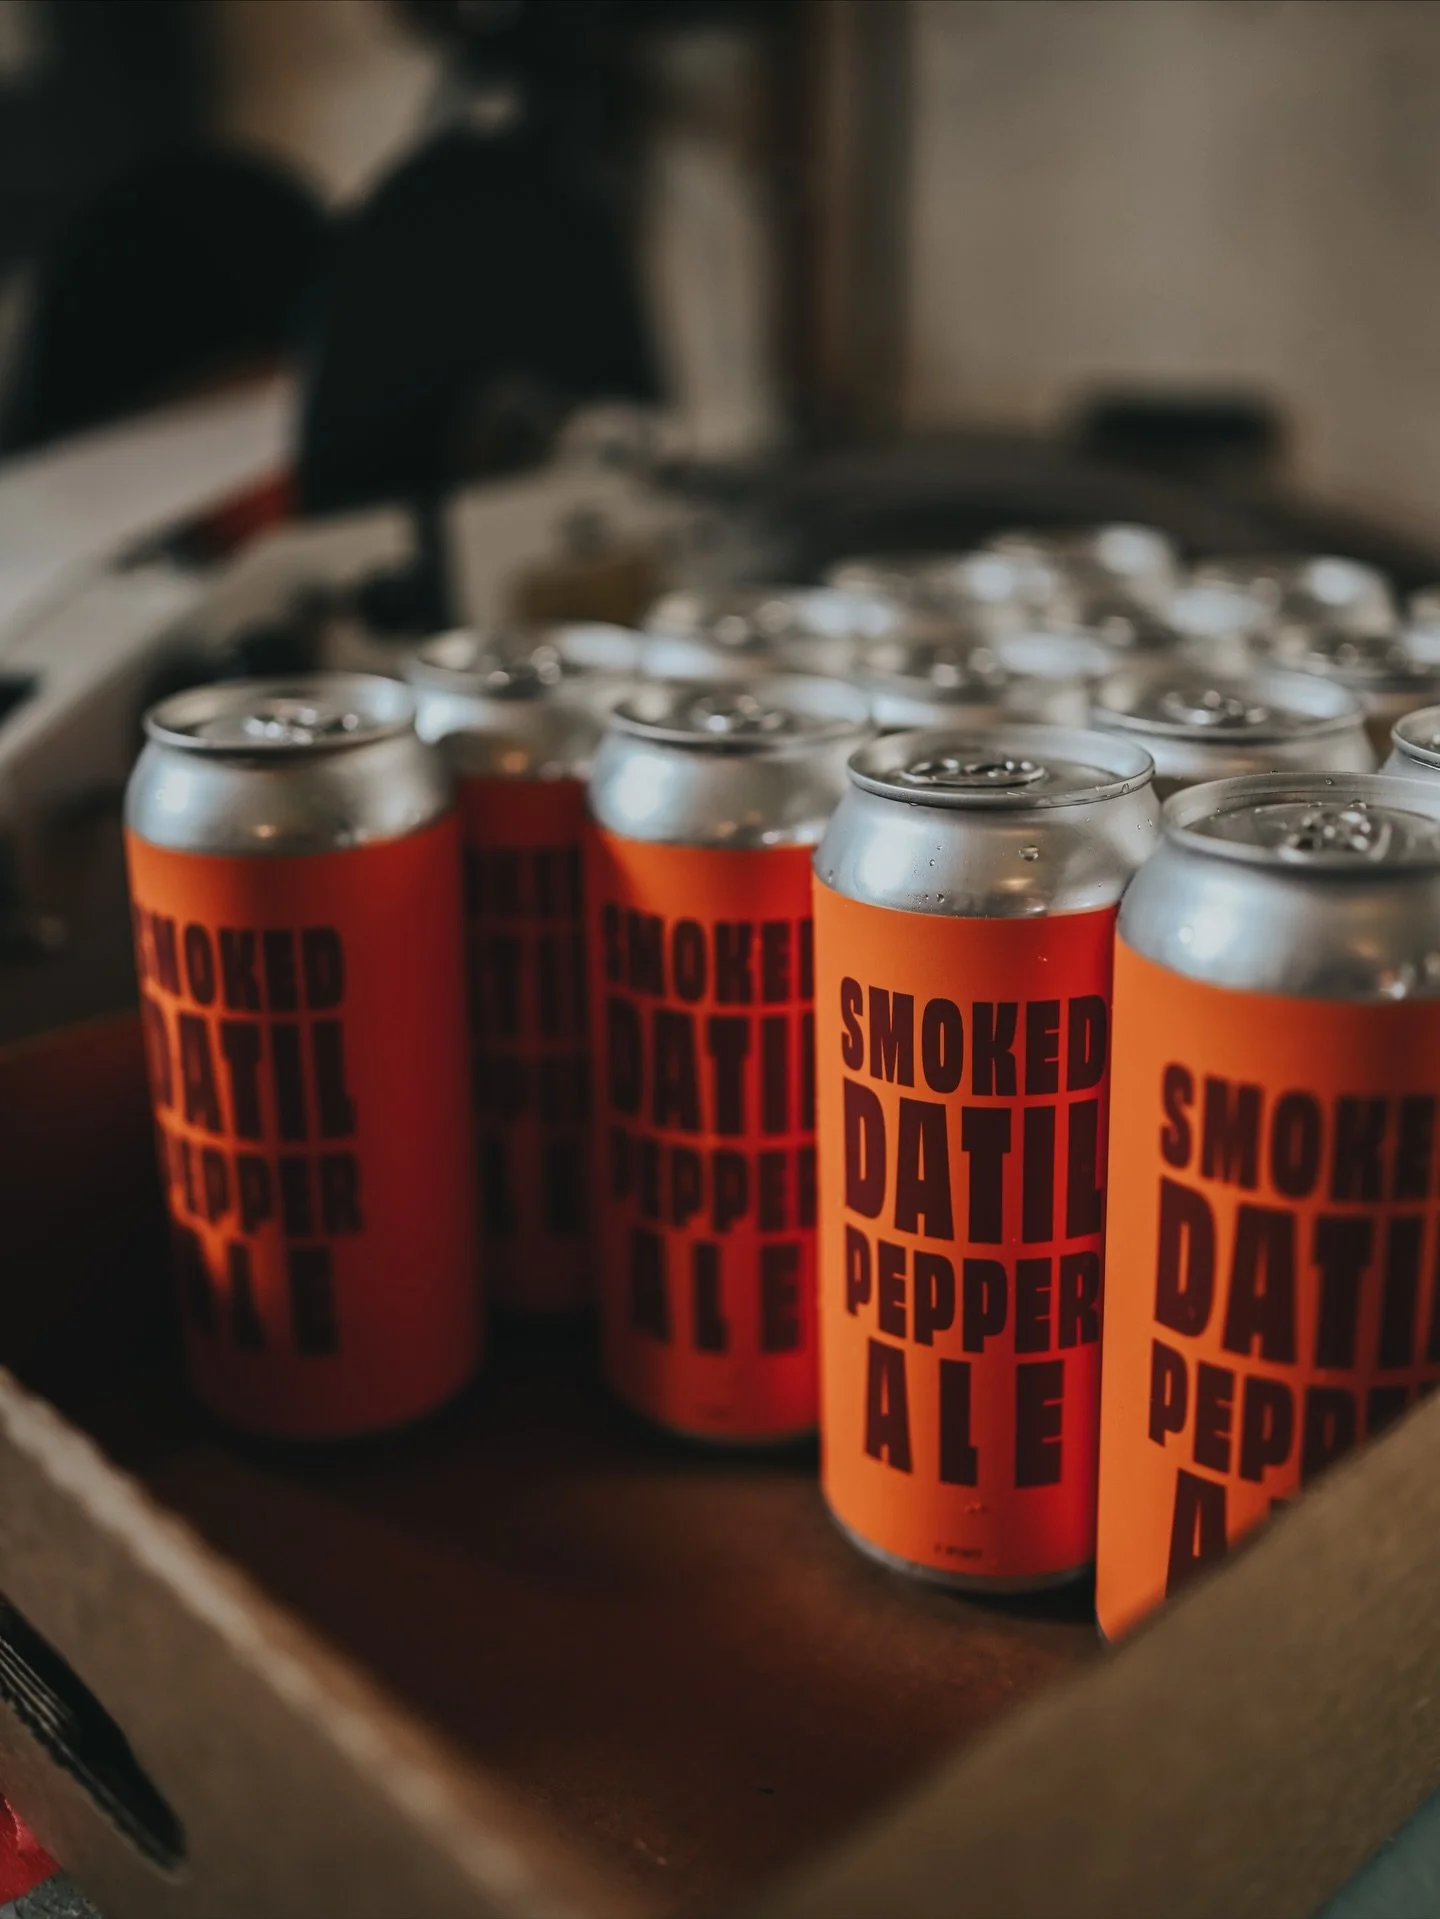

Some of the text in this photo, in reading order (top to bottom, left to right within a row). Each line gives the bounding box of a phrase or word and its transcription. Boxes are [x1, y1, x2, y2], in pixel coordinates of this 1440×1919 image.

[135, 902, 346, 1011] MOKED
[840, 976, 1107, 1096] SMOKED
[843, 1076, 1105, 1244] DATIL
[1159, 1062, 1440, 1204] SMOKE
[630, 1224, 801, 1354] ALE
[845, 1223, 1102, 1355] PEPPER
[1154, 1174, 1440, 1370] DATI
[864, 1336, 1065, 1489] ALE
[1148, 1337, 1440, 1489] PEPP
